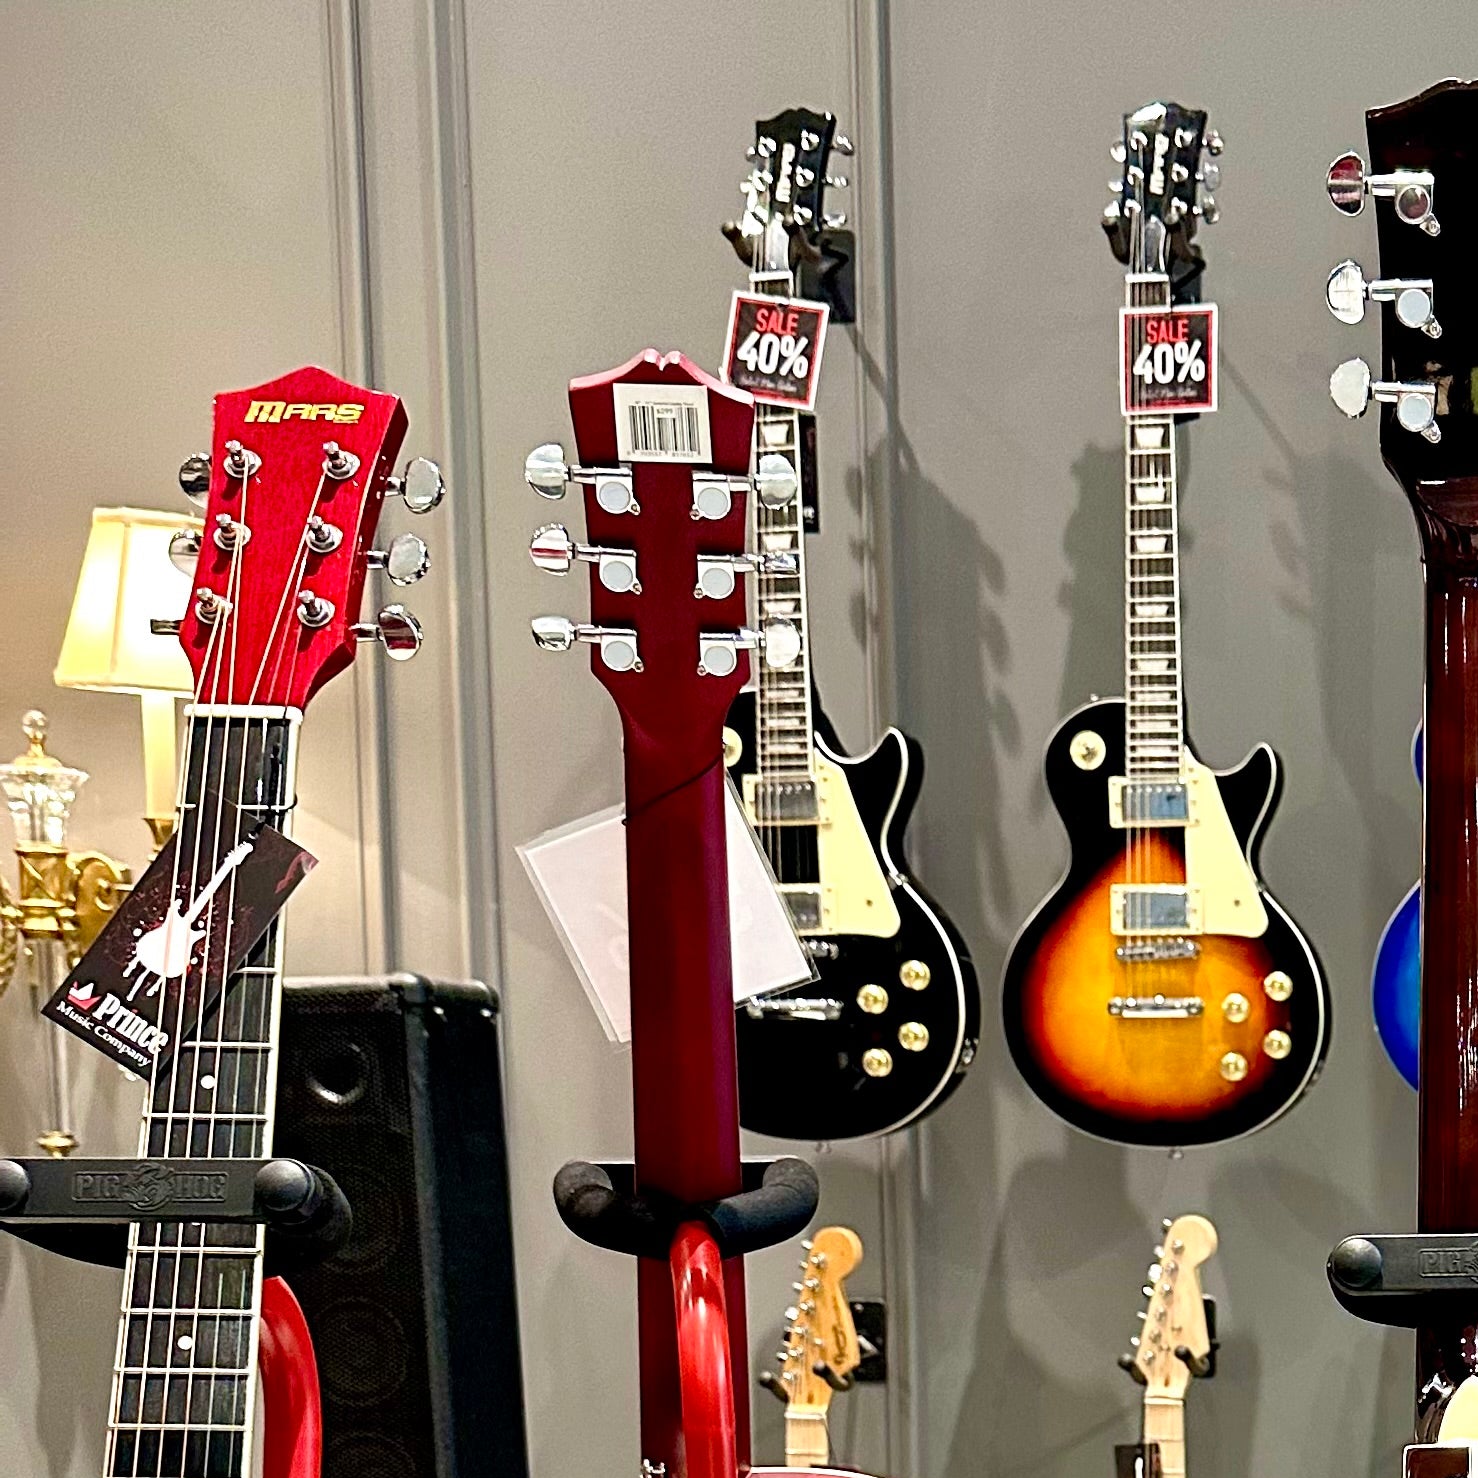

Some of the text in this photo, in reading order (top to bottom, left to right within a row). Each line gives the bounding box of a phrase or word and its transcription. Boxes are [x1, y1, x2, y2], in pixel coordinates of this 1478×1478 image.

[755, 307, 800, 336] SALE
[1146, 318, 1190, 344] SALE
[736, 330, 809, 379] 40%
[1132, 339, 1206, 385] 40%
[243, 400, 365, 424] MARS
[56, 1000, 152, 1067] Music Company
[92, 993, 169, 1054] Prince
[77, 1174, 226, 1198] PIG HOG
[1422, 1250, 1461, 1273] PIG
